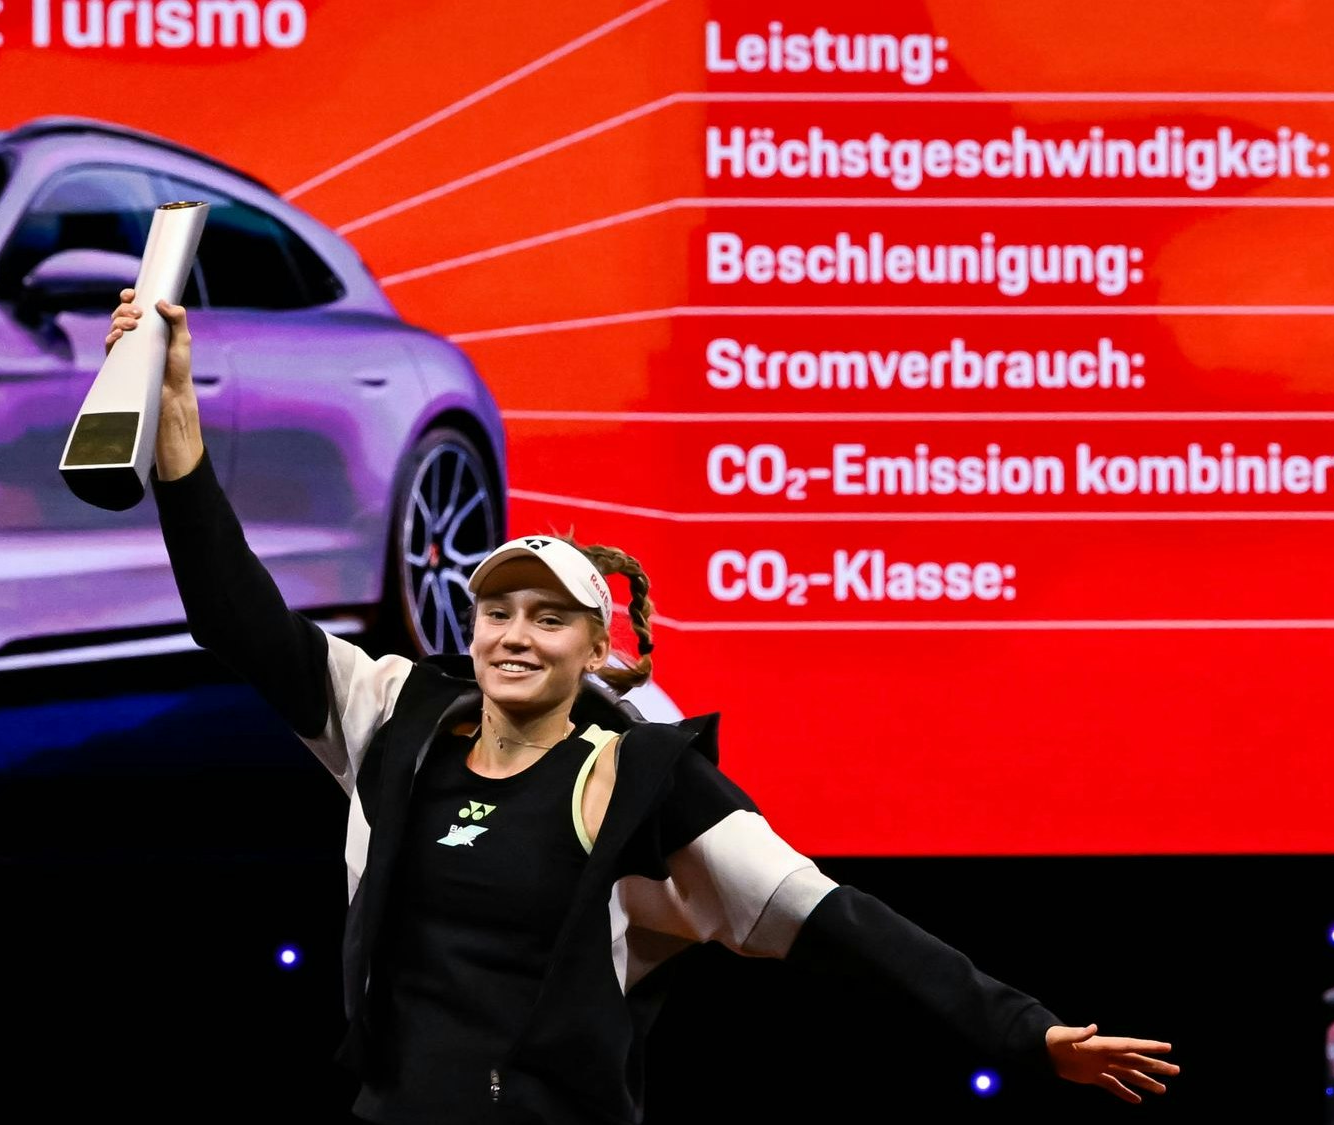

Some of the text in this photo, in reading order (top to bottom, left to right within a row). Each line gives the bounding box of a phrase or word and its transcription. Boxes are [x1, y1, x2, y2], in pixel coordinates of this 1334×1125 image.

[32, 0, 307, 48] Turismo
[705, 21, 949, 85] Leistung:
[705, 126, 1331, 190] Höchstgeschwindigkeit:
[706, 232, 1144, 296] Beschleunigung:
[705, 338, 1146, 389] Stromverbrauch:
